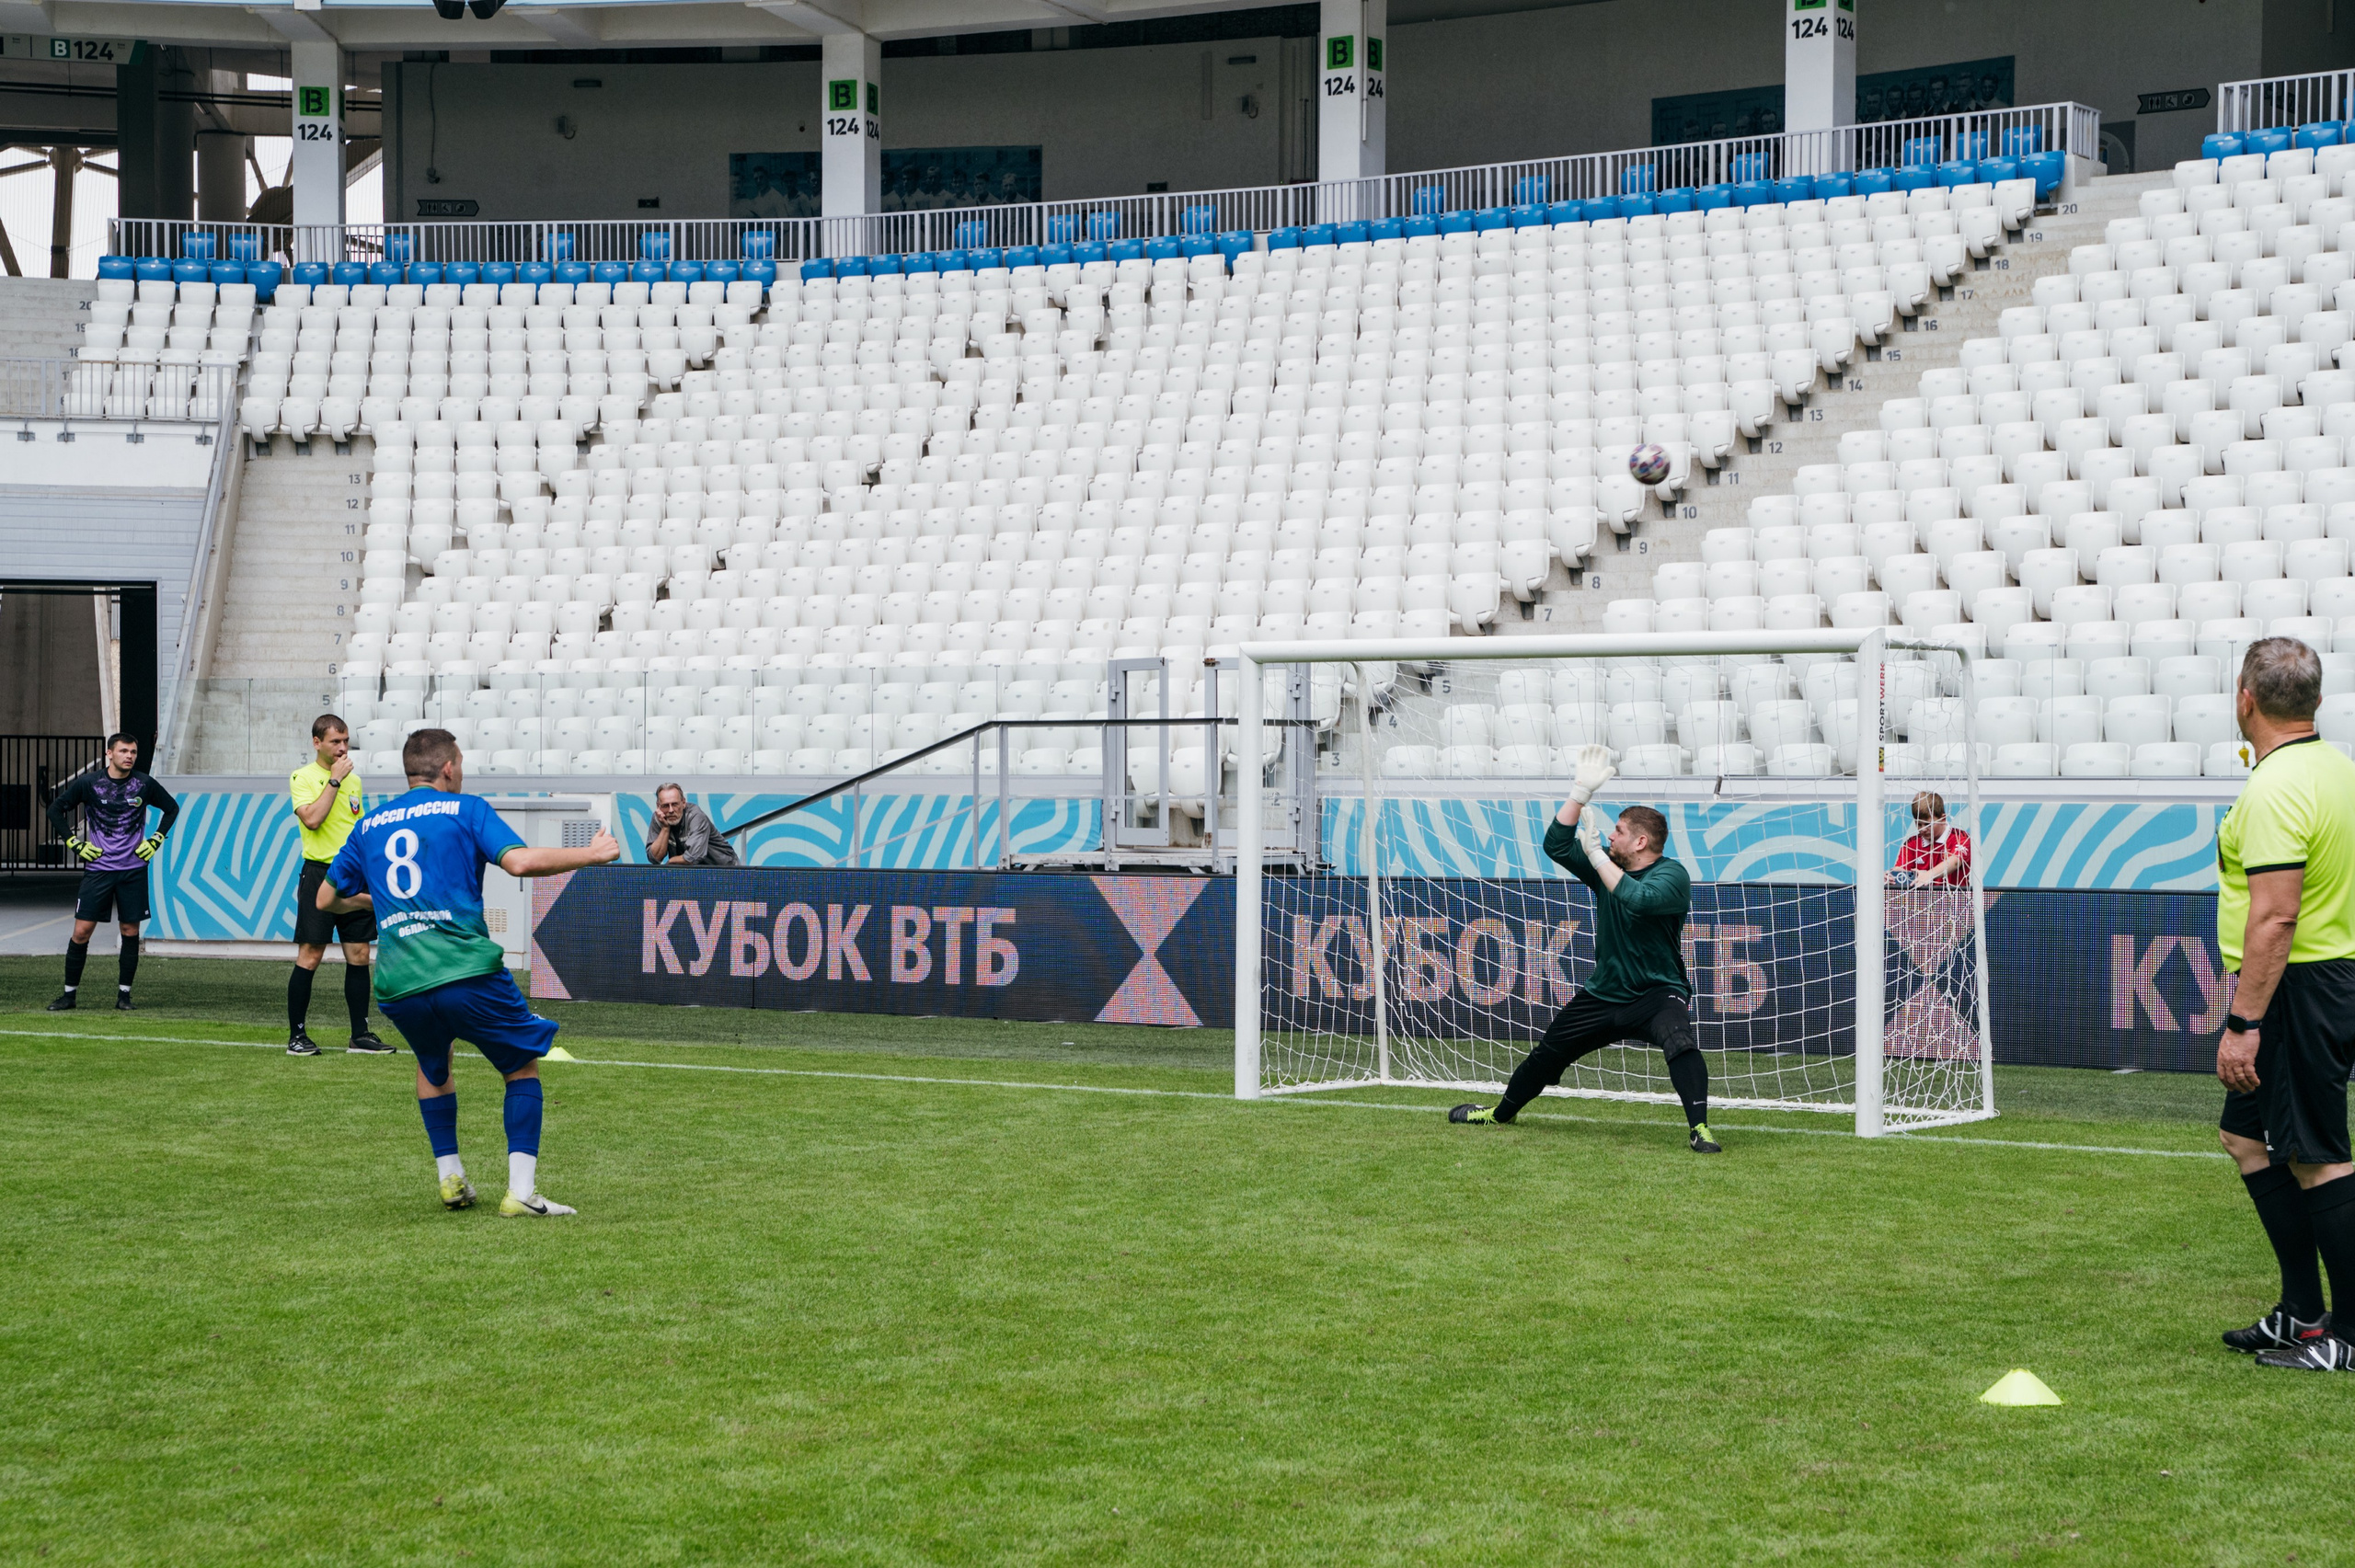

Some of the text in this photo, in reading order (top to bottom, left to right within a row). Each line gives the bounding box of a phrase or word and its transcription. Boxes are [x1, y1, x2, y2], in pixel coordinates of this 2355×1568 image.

[1792, 17, 1829, 39] 124
[1836, 17, 1854, 40] 124
[54, 40, 114, 61] B 124
[1332, 39, 1349, 65] B
[1325, 75, 1355, 96] 124
[1367, 77, 1384, 98] 24
[304, 88, 323, 113] B
[834, 83, 852, 108] B
[297, 123, 333, 141] 124
[827, 117, 860, 136] 124
[866, 120, 879, 141] 124
[2062, 203, 2078, 215] 20
[2029, 232, 2043, 243] 19
[1994, 258, 2010, 270] 18
[1960, 289, 1974, 301] 17
[1923, 319, 1938, 332] 16
[1886, 349, 1901, 361] 15
[1848, 379, 1864, 392] 14
[1809, 409, 1824, 422] 13
[1768, 441, 1783, 454] 12
[349, 474, 361, 485] 13
[1728, 472, 1740, 485] 11
[346, 498, 359, 509] 12
[1682, 506, 1697, 520] 10
[344, 524, 355, 535] 11
[1639, 541, 1648, 555] 9
[340, 551, 354, 562] 10
[340, 578, 349, 590] 9
[1591, 576, 1601, 589] 8
[337, 605, 345, 616] 8
[1544, 608, 1553, 622] 7
[334, 633, 342, 645] 7
[328, 663, 337, 675] 6
[1442, 680, 1452, 694] 5
[322, 694, 331, 706] 5
[1388, 715, 1397, 728] 4
[301, 752, 308, 765] 3
[1331, 752, 1340, 766] 3
[371, 807, 407, 828] ФССП
[406, 800, 461, 820] РОССИИ
[384, 828, 422, 899] 8
[642, 898, 1020, 986] КУБОК ВТБ
[1292, 914, 1768, 1013] КУБОК ТБ
